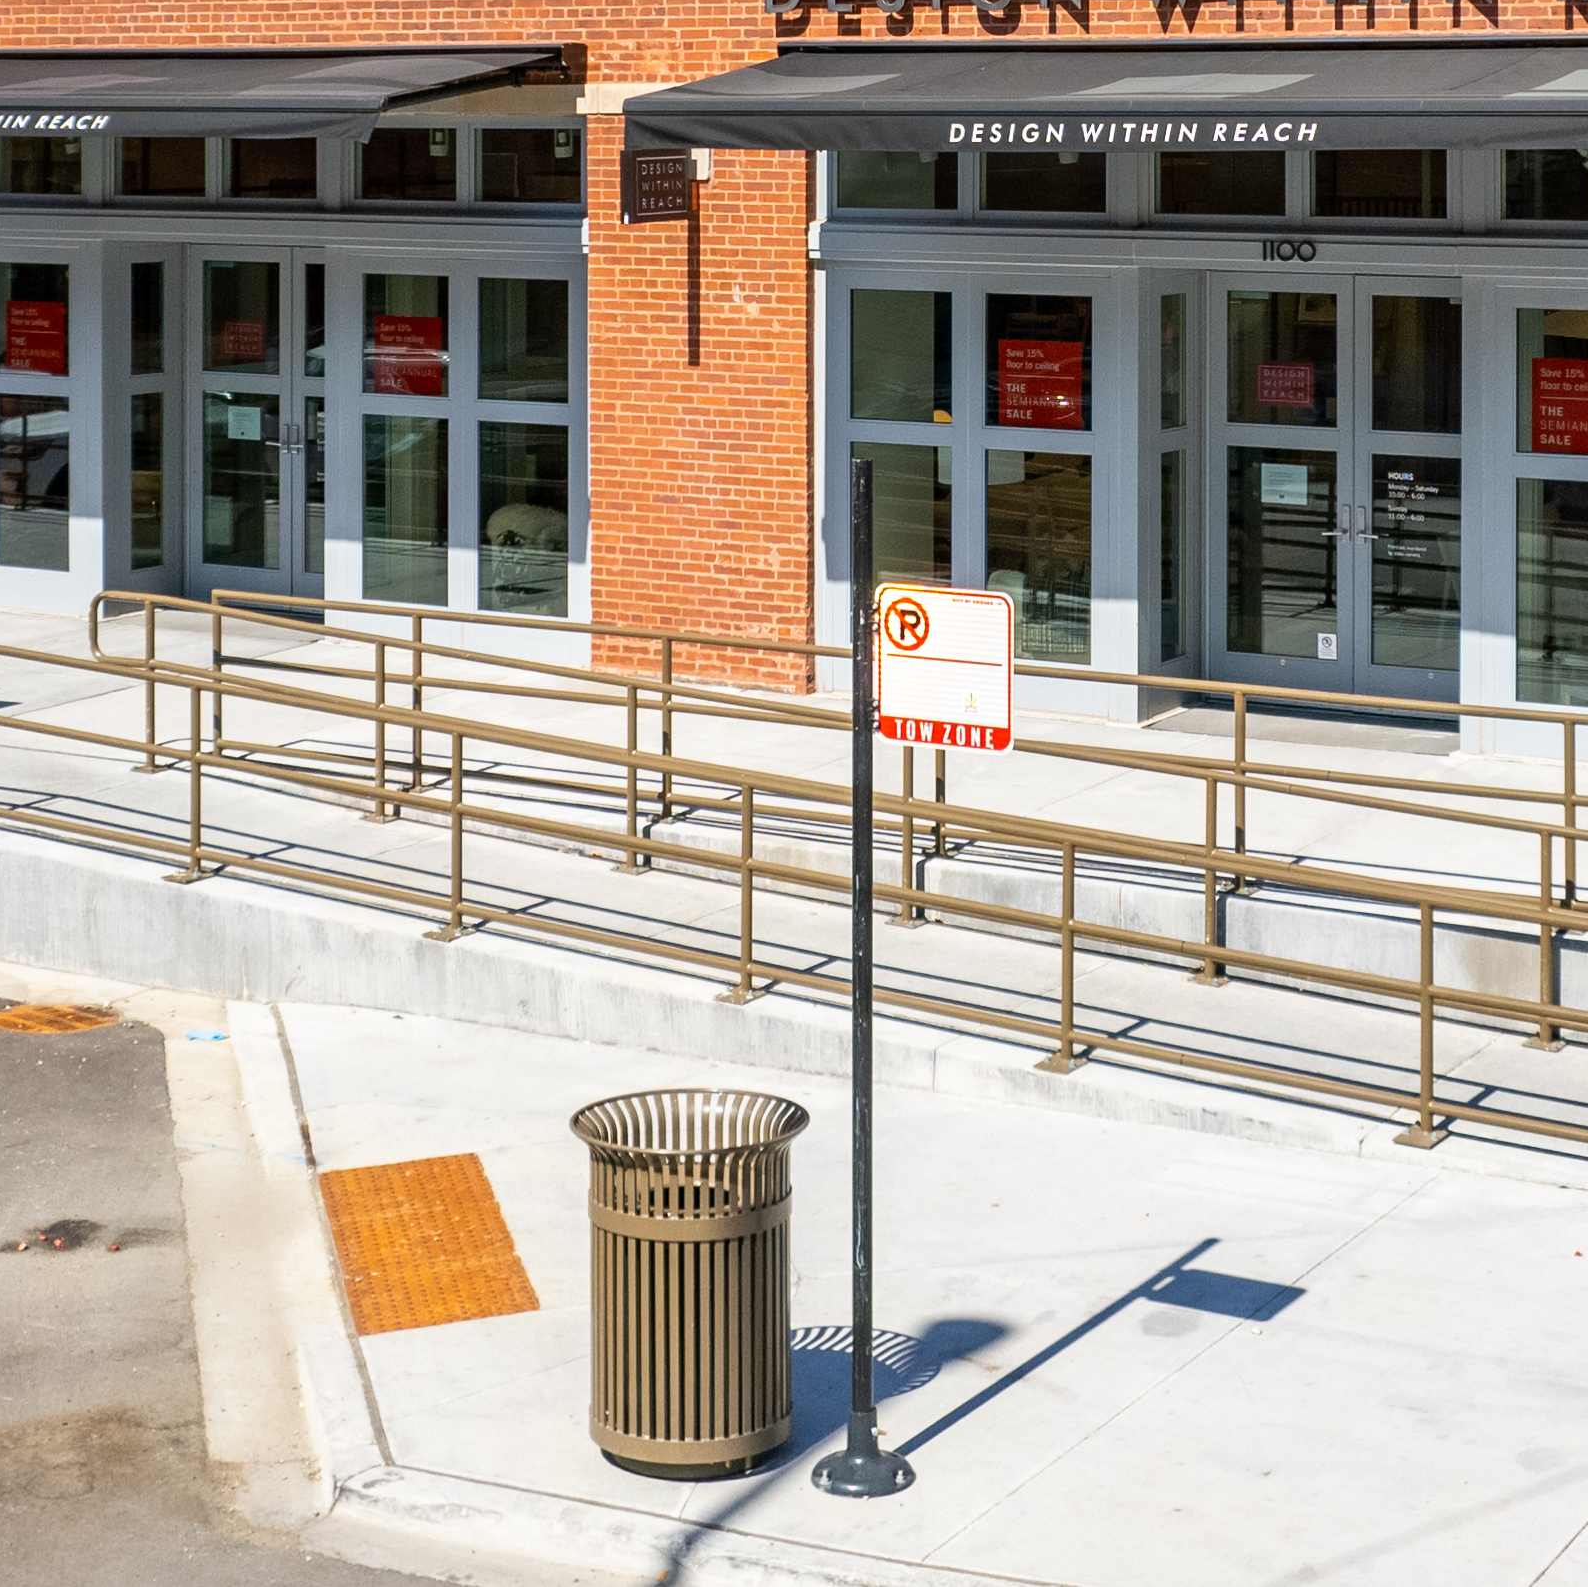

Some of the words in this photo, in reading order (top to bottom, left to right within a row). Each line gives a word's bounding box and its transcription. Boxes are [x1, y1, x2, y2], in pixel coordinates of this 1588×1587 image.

[34, 115, 110, 130] REACH
[949, 122, 1065, 143] DESIGN
[1081, 122, 1198, 143] WITHIN
[1212, 122, 1318, 143] REACH
[641, 162, 683, 176] DESIGN
[641, 180, 683, 192] WITHIN
[641, 196, 683, 209] REACH
[1262, 239, 1317, 262] 1100
[1006, 348, 1024, 357] Save
[1026, 349, 1044, 358] 15%
[1006, 360, 1023, 369] floor
[1025, 361, 1033, 369] to
[1035, 362, 1059, 372] ceiling
[1263, 368, 1305, 378] DESIGN
[1540, 368, 1561, 377] Save
[1565, 368, 1585, 378] 15%
[380, 378, 402, 388] SALE
[1006, 383, 1026, 393] THE
[1263, 380, 1305, 388] WITHIN
[1540, 381, 1560, 390] floor
[1563, 382, 1572, 391] to
[1263, 390, 1305, 399] REACH
[1006, 409, 1032, 420] SALE
[1540, 405, 1564, 416] THE
[1540, 433, 1571, 446] SALE
[1388, 472, 1414, 481] HOURS
[1388, 483, 1410, 492] Monday
[1388, 491, 1405, 499] 10:00
[1411, 514, 1425, 522] 6:00
[894, 718, 933, 742] TOW
[942, 724, 995, 750] ZONE
